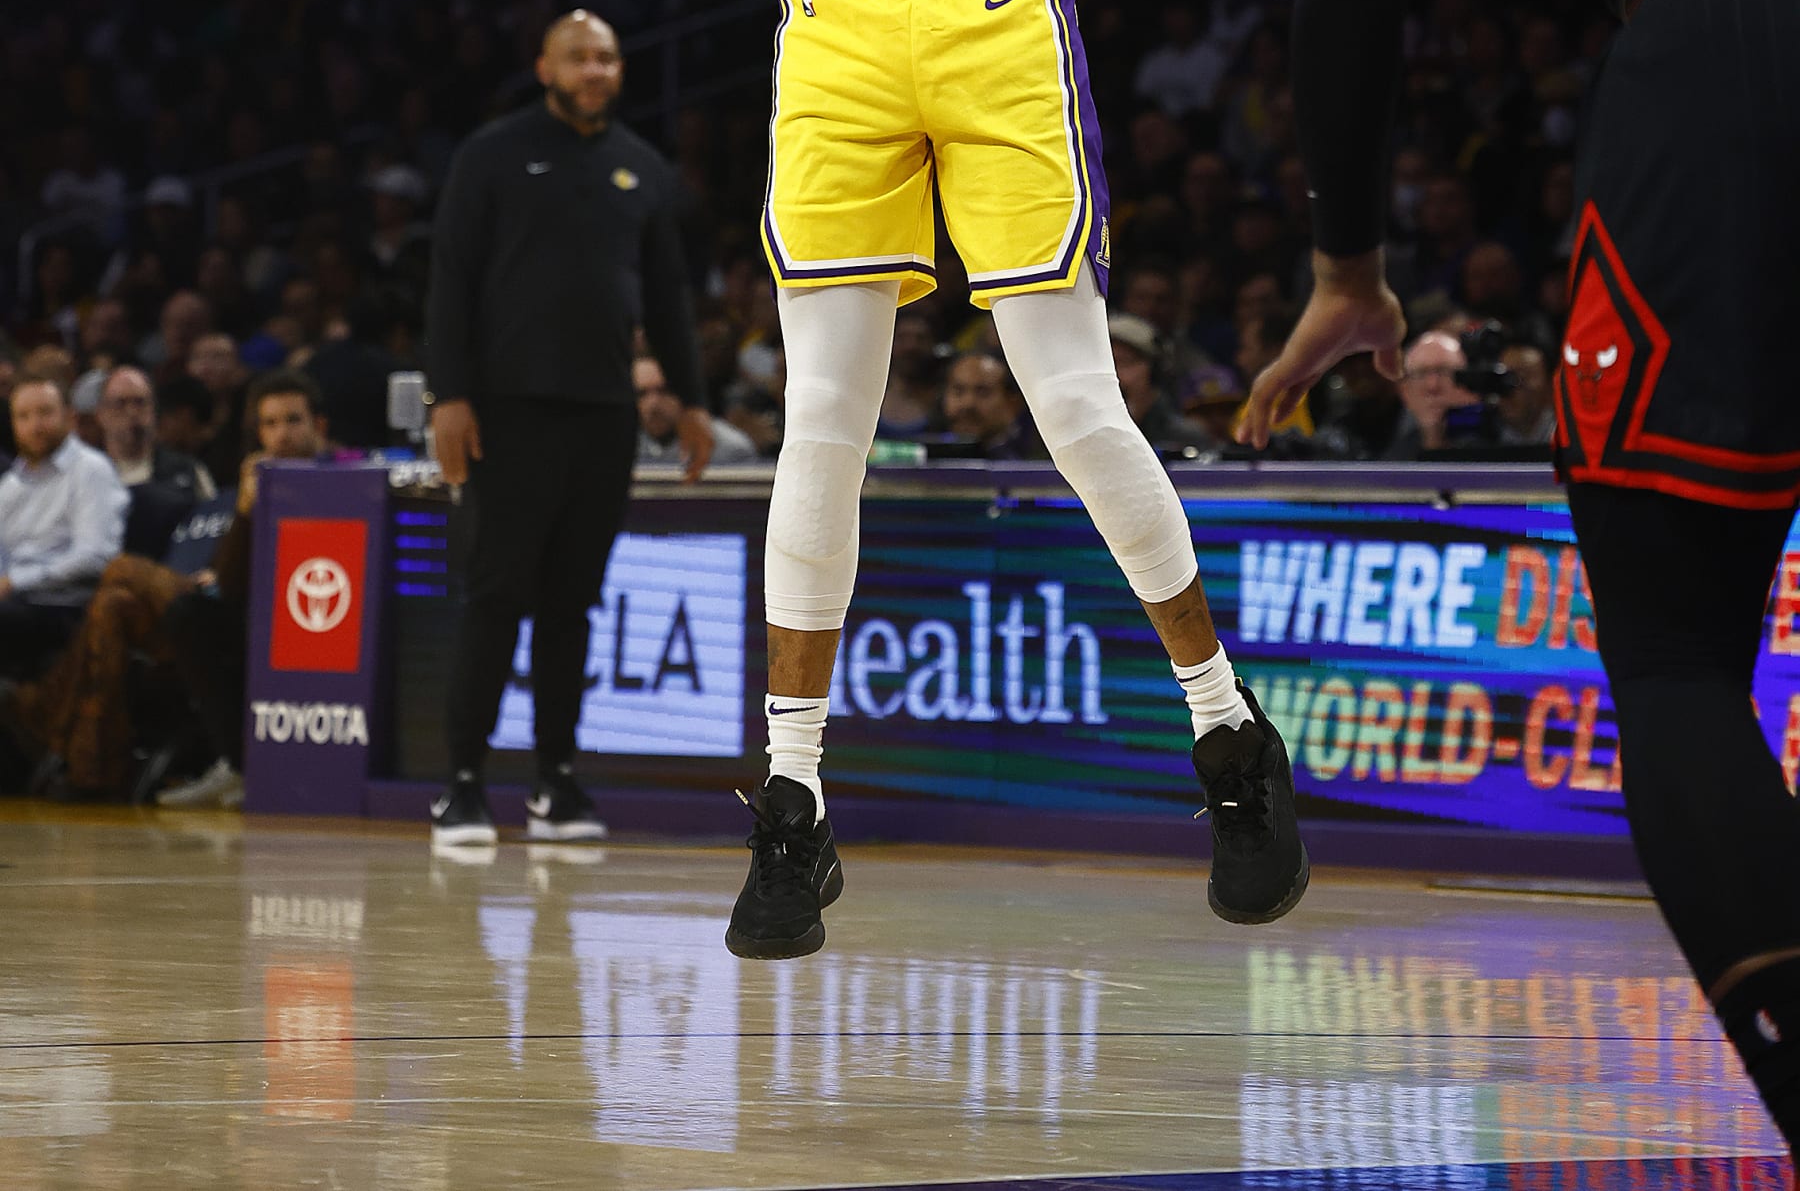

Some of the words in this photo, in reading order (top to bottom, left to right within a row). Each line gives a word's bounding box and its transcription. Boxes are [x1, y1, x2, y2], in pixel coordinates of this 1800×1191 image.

[1239, 541, 1488, 648] WHERE
[829, 581, 1108, 724] ealth
[251, 702, 370, 746] TOYOTA
[1252, 676, 1623, 793] WORLD-CL
